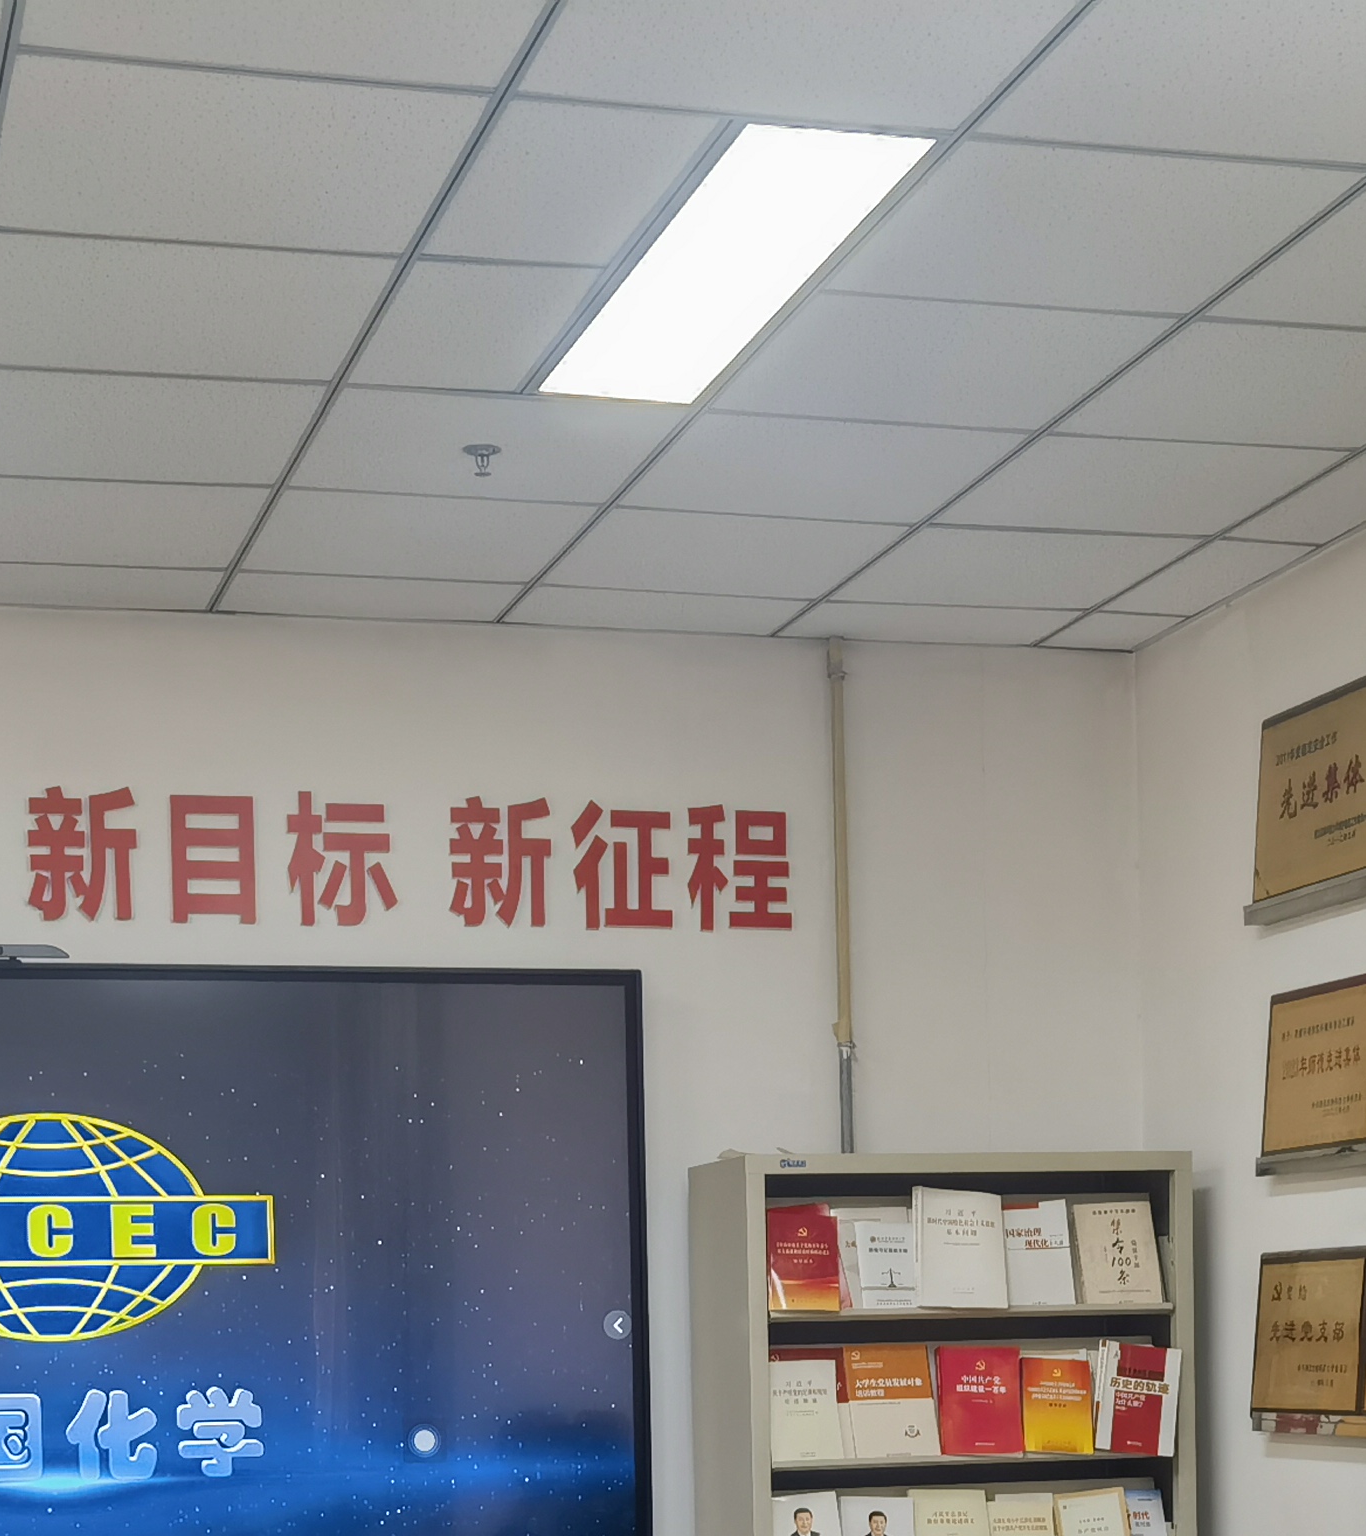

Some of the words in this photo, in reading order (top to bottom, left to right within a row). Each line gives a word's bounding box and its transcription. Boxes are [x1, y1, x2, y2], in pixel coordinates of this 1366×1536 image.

[1279, 754, 1365, 820] 先进集体
[26, 786, 398, 928] 新目标
[449, 795, 795, 932] 新征程
[1269, 1320, 1345, 1343] 先进党支部
[961, 1374, 1002, 1385] 中国共产党
[1110, 1377, 1170, 1394] 历史的轨迹
